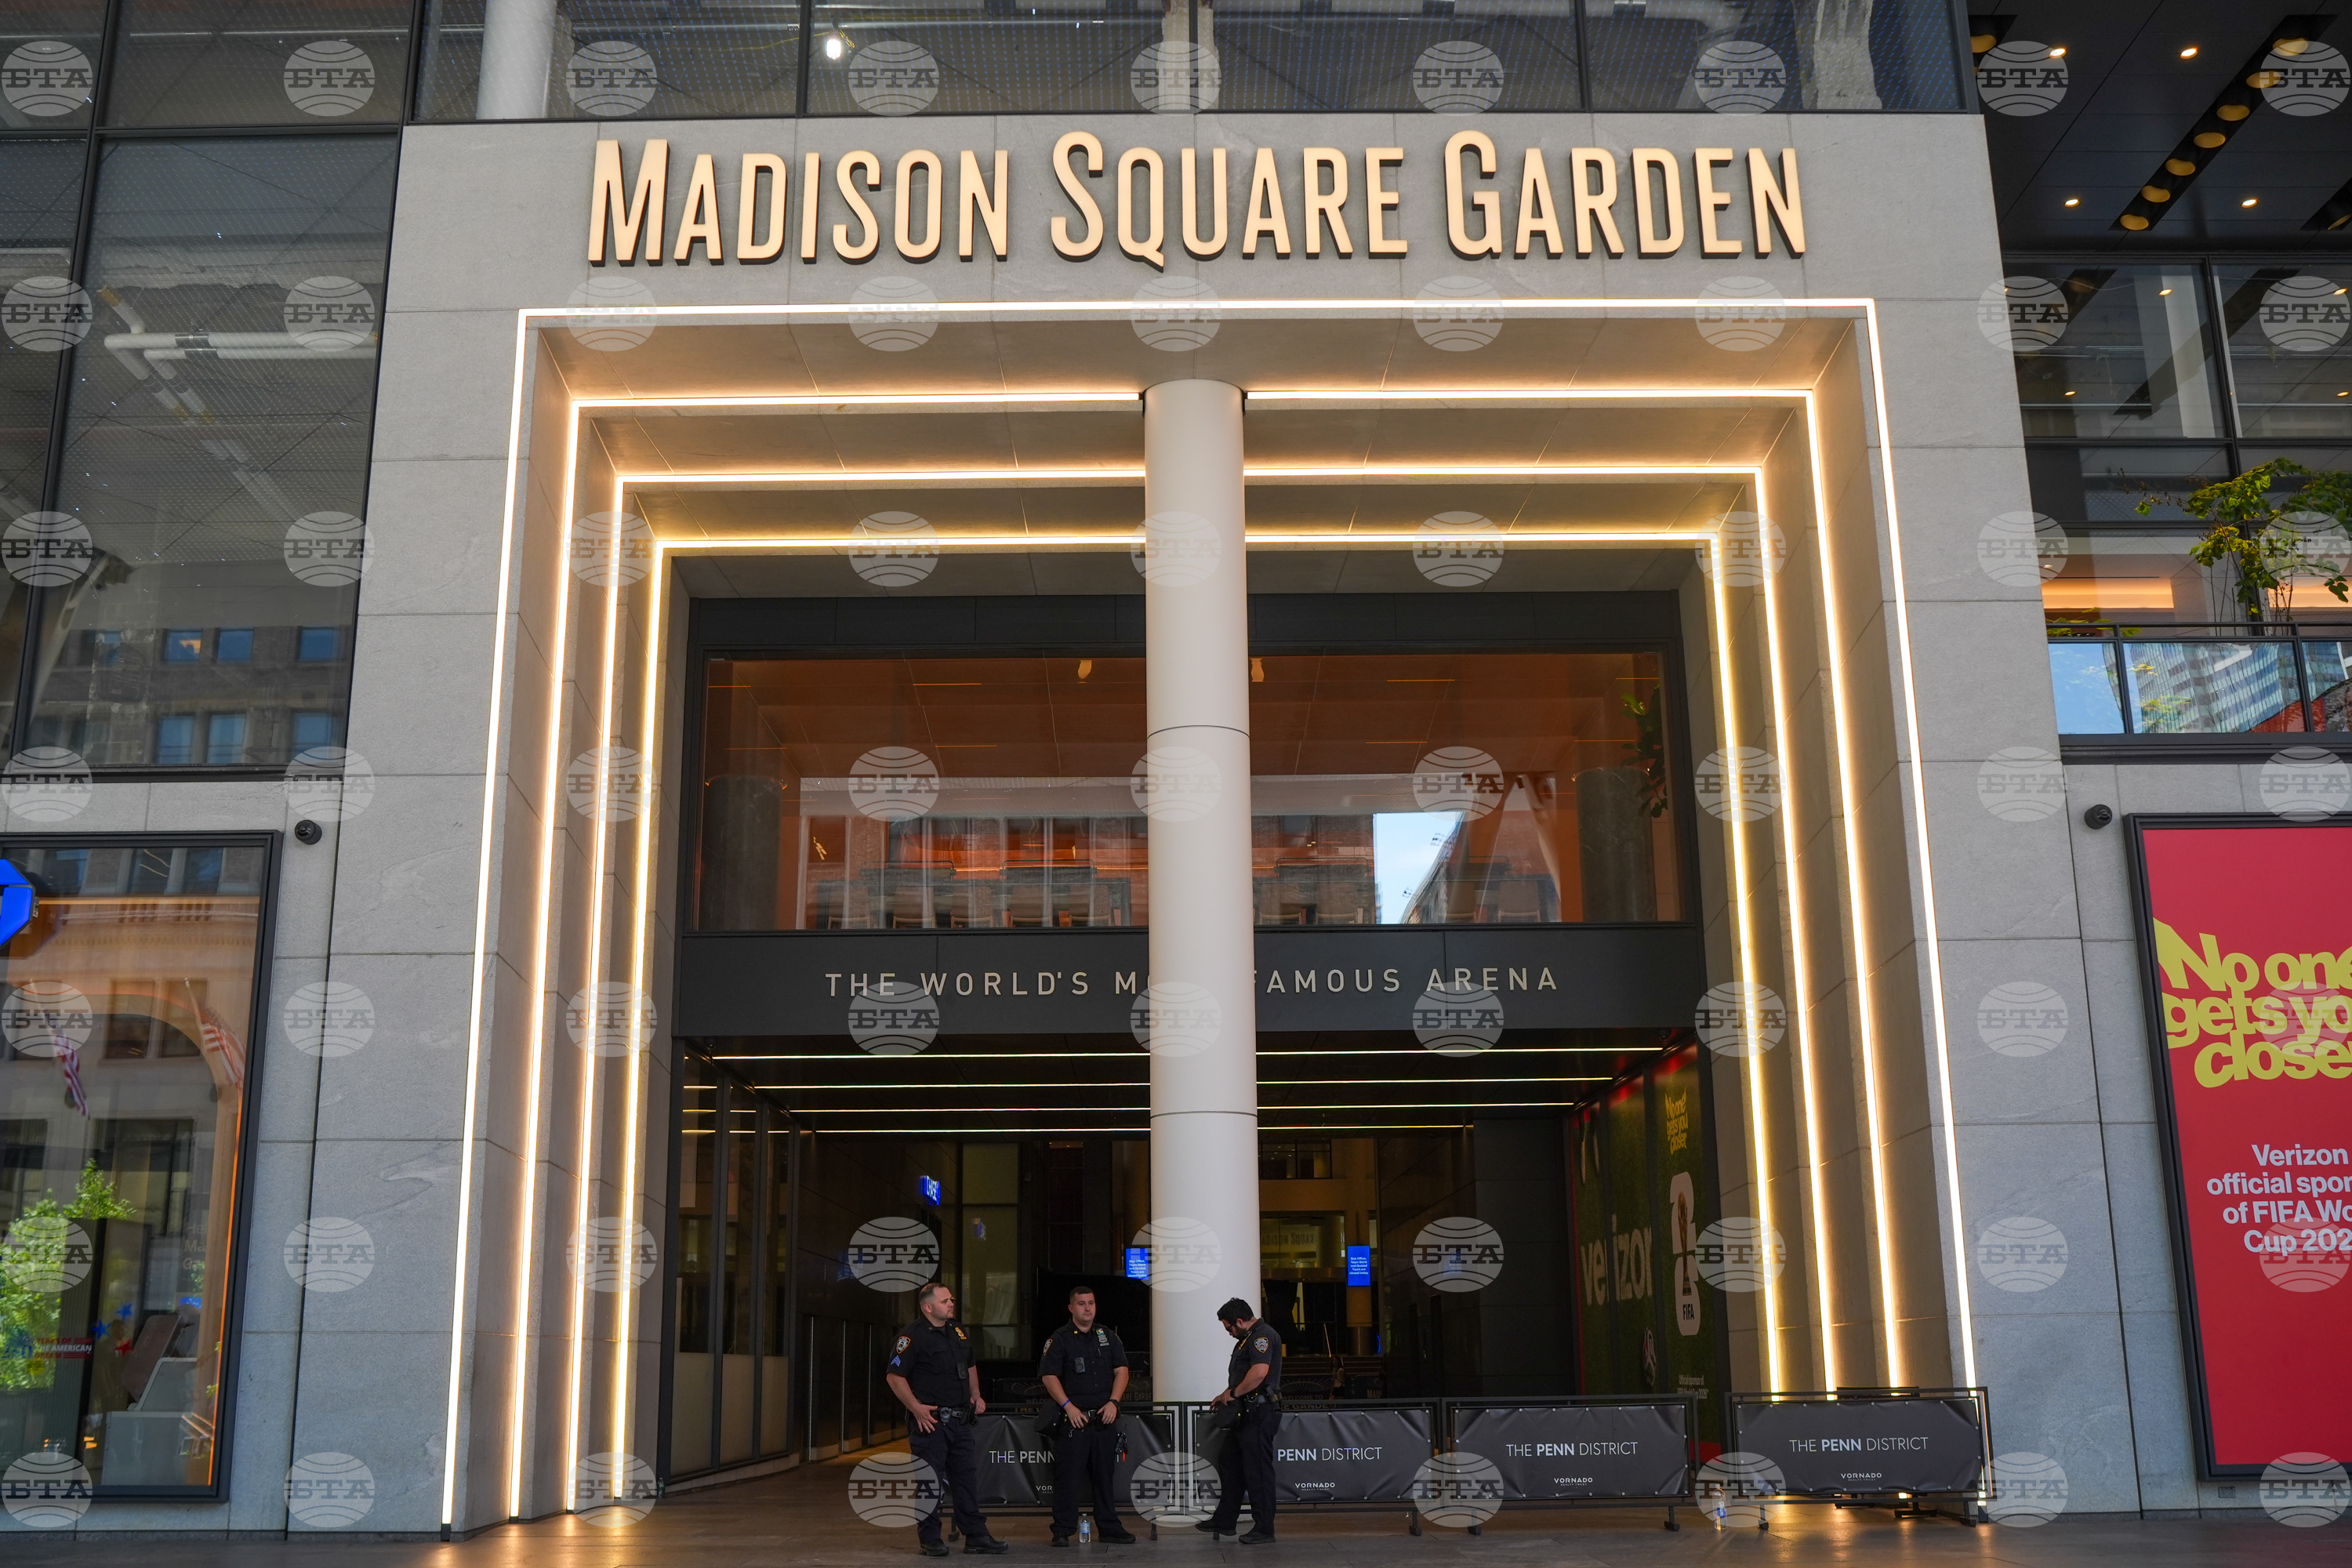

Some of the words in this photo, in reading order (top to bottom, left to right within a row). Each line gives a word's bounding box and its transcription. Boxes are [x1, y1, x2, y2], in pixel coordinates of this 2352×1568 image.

[587, 138, 1010, 265] MADISON
[1051, 130, 1409, 271] SQUARE
[1444, 129, 1806, 260] GARDEN
[2153, 916, 2260, 992] No
[825, 972, 895, 996] THE
[920, 971, 1089, 996] WORLD'S
[1426, 967, 1558, 992] ARENA
[2161, 991, 2288, 1050] gets
[2194, 1029, 2352, 1088] close
[2251, 1143, 2349, 1167] Verizon
[2206, 1171, 2292, 1196] official
[2223, 1201, 2249, 1225] of
[2252, 1200, 2314, 1223] FIFA
[1261, 1234, 1288, 1246] ADISON
[2244, 1229, 2297, 1257] Cup
[1682, 1303, 1695, 1321] FIFA
[1134, 1392, 1152, 1401] GARDE
[1277, 1448, 1317, 1461] PENN
[1322, 1446, 1382, 1461] DISTRICT
[1506, 1443, 1532, 1457] THE
[1537, 1443, 1575, 1456] PENN
[1579, 1442, 1639, 1456] DISTRICT
[1789, 1439, 1817, 1452] THE
[1821, 1438, 1862, 1452] PENN
[1867, 1436, 1929, 1450] DISTRICT
[989, 1450, 1015, 1464] THE
